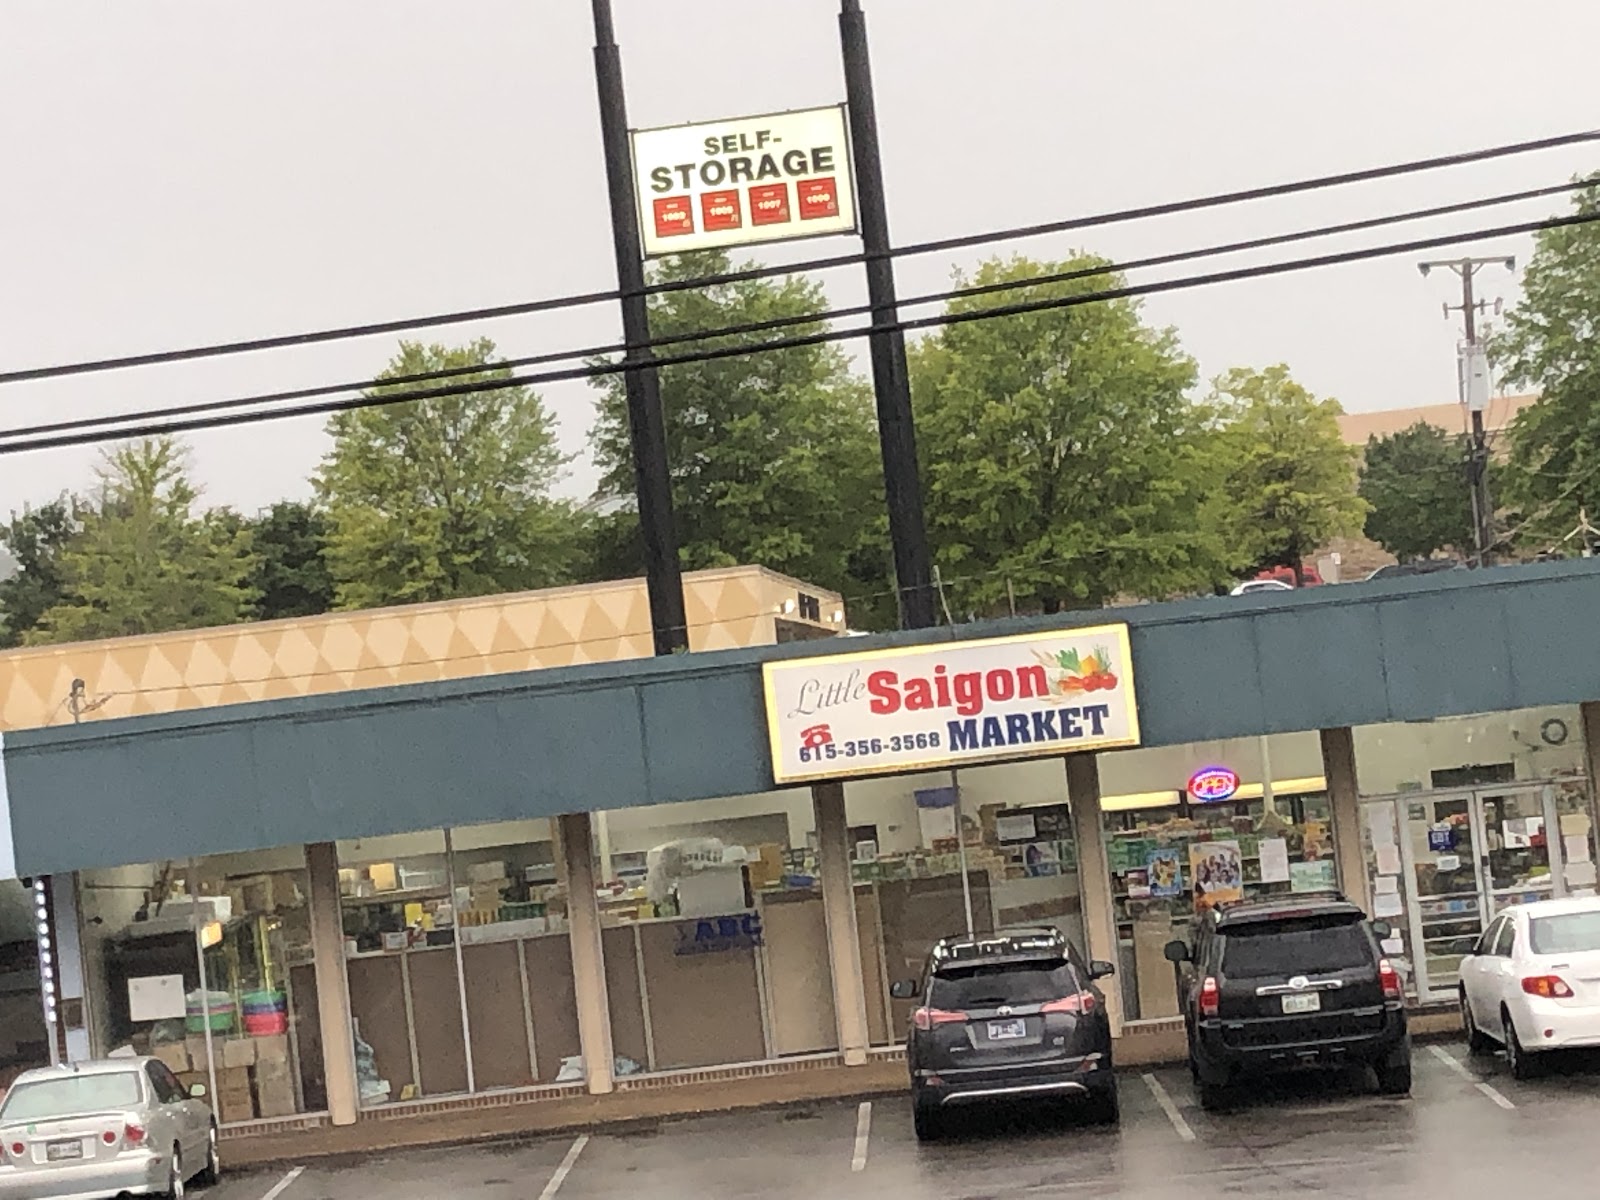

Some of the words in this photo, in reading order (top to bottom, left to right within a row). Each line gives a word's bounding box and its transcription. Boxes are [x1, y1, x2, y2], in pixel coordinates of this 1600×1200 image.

[704, 130, 782, 156] SELF-
[650, 146, 836, 193] STORAGE
[787, 668, 867, 718] Little
[867, 664, 1050, 716] Saigon
[799, 731, 941, 763] 615-356-3568
[947, 704, 1109, 752] MARKET
